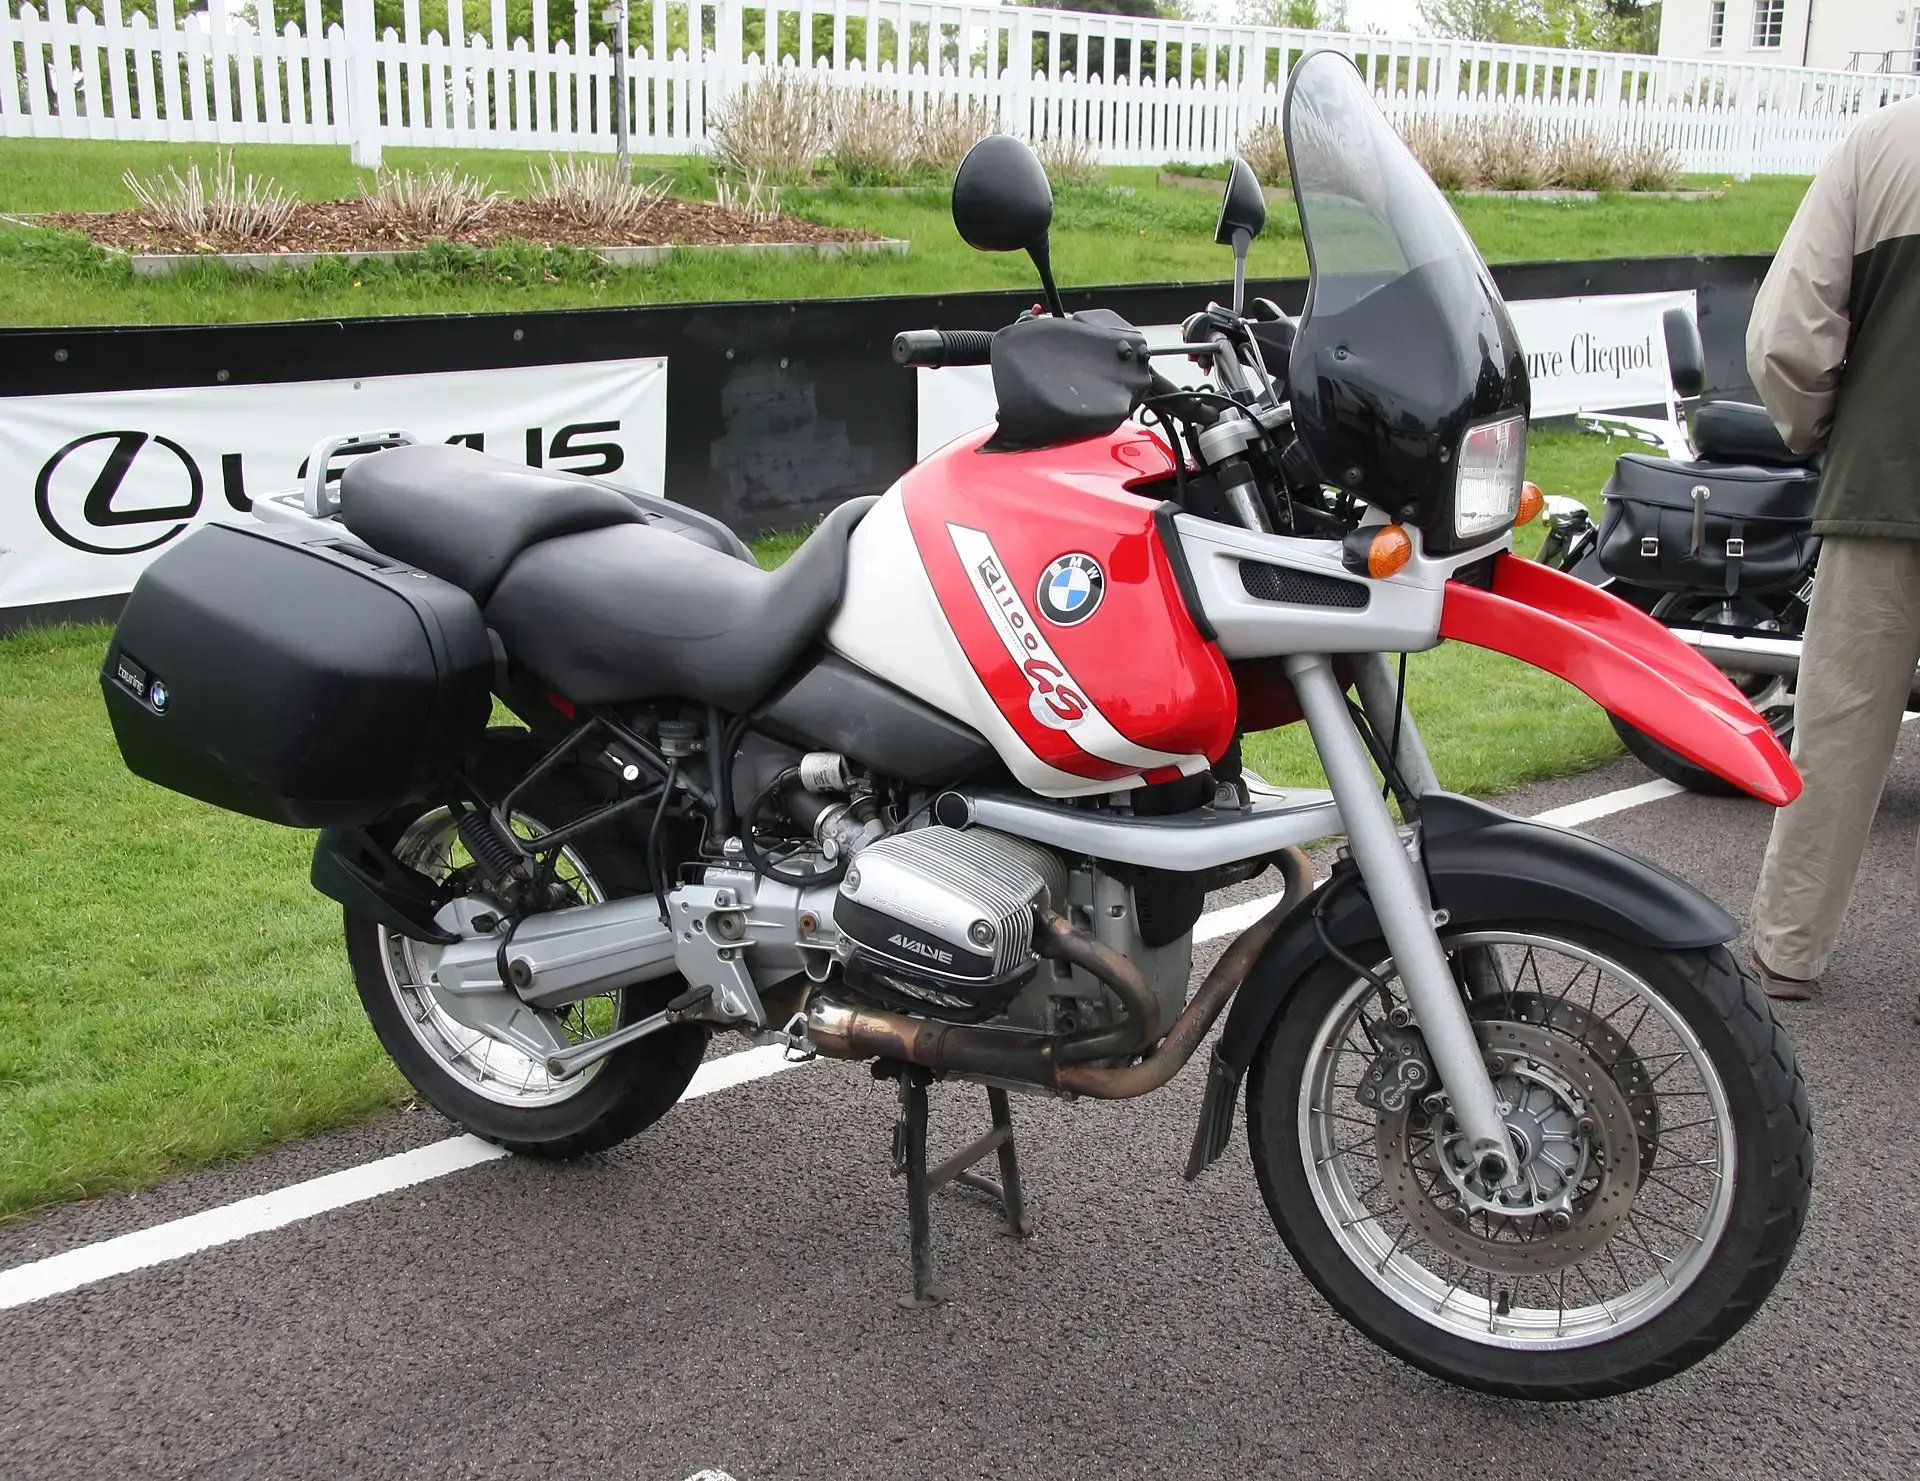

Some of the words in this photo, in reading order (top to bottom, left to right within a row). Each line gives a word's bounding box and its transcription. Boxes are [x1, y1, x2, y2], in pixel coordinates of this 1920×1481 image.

[1526, 350, 1563, 380] uve
[1570, 332, 1654, 379] Clicquot
[1049, 556, 1100, 580] BMW
[117, 663, 145, 697] touring
[1024, 658, 1088, 721] GS
[887, 933, 953, 965] 4VALVE
[1386, 1079, 1411, 1106] brembo
